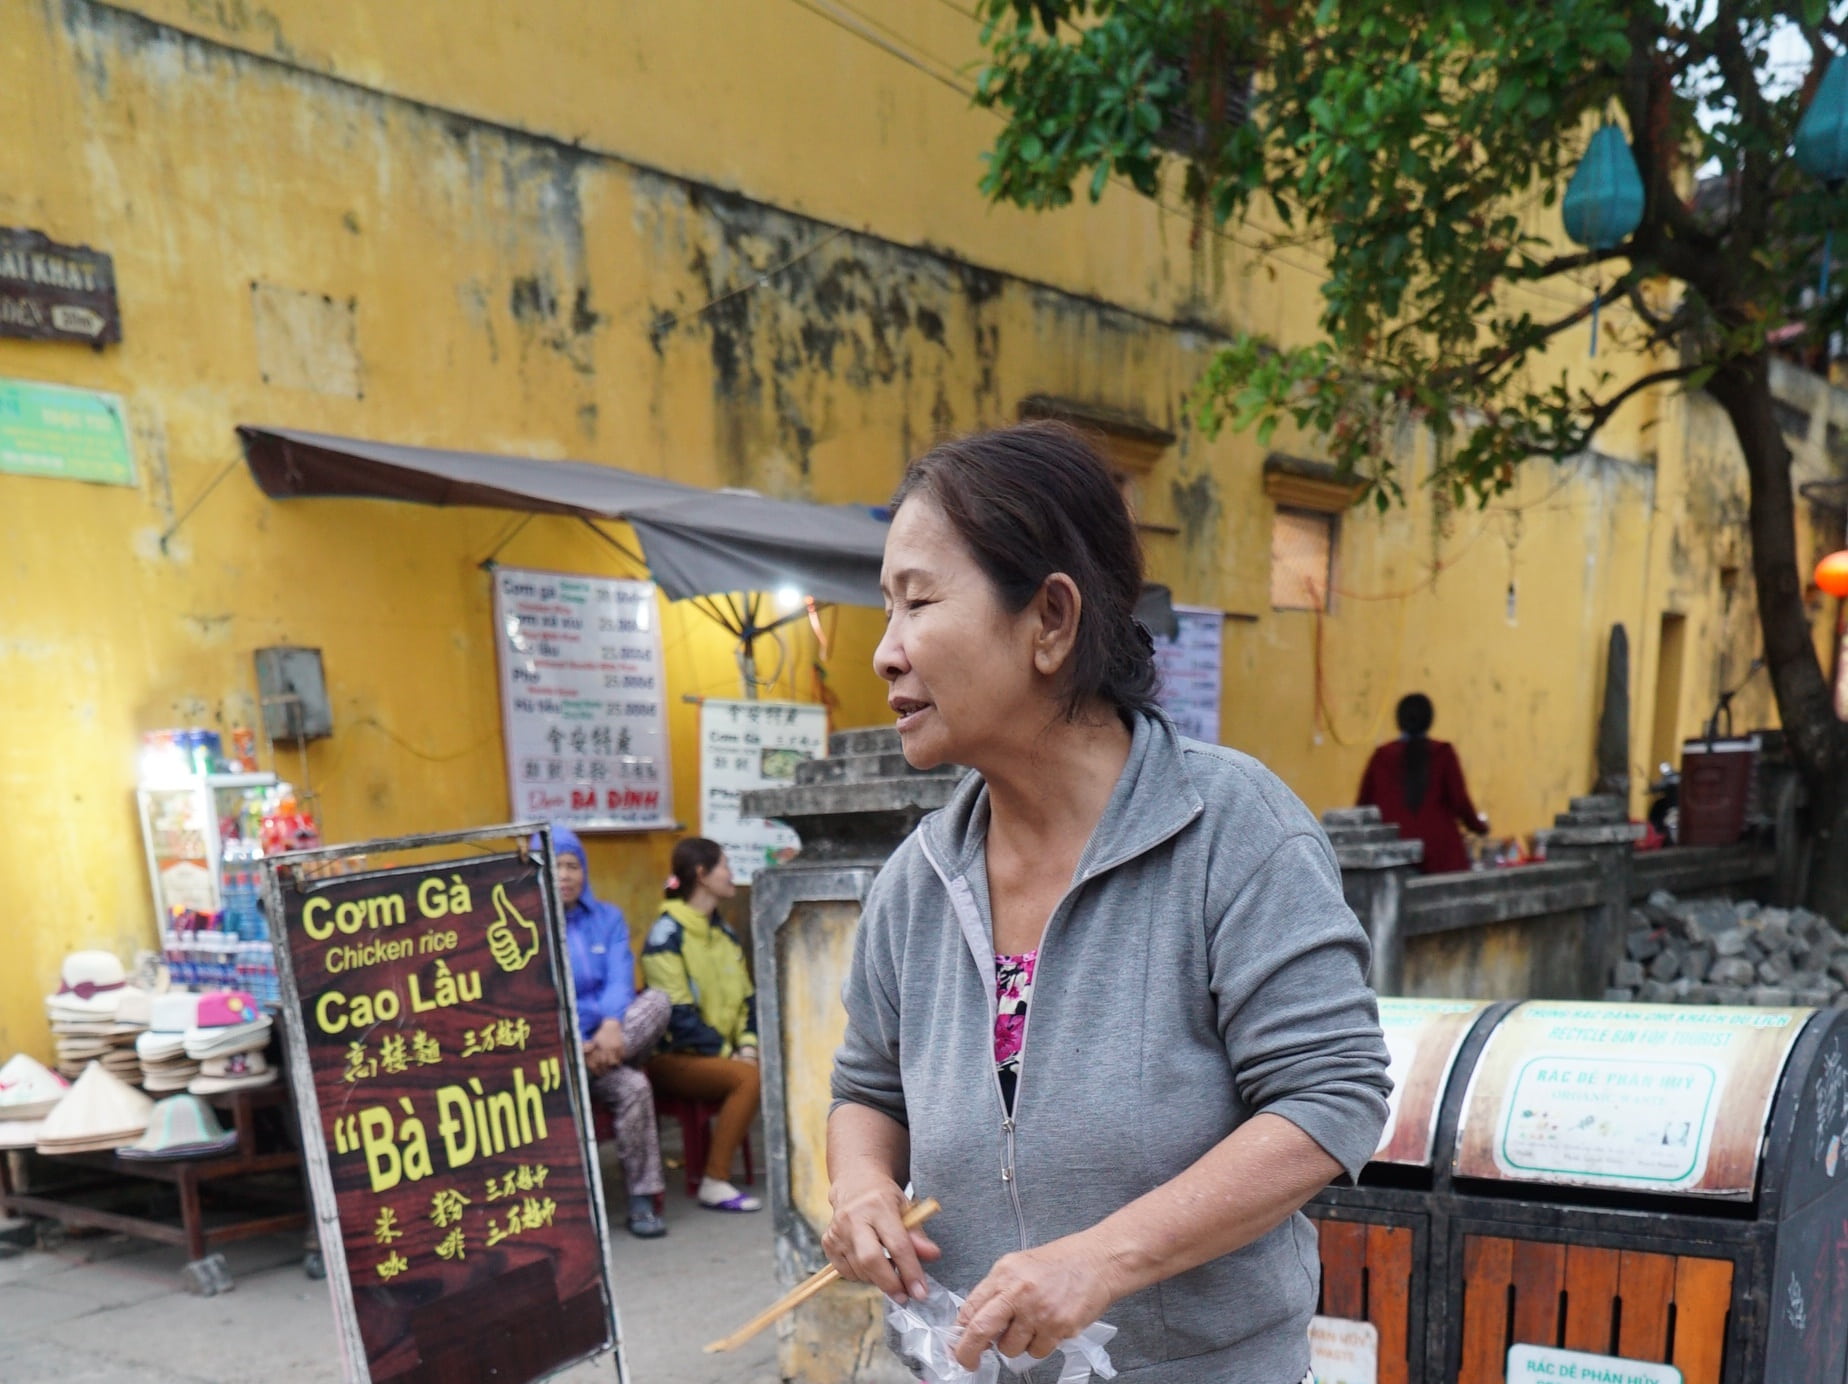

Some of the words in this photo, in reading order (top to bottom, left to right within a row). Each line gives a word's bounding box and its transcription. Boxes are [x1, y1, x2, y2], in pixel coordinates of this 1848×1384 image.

[302, 893, 406, 940] Cơm
[417, 874, 473, 919] Gà
[325, 938, 413, 973] Chicken
[419, 929, 458, 954] rice
[316, 989, 400, 1034] Cao
[408, 958, 483, 1014] Lầu
[1526, 1356, 1555, 1375] RÁC
